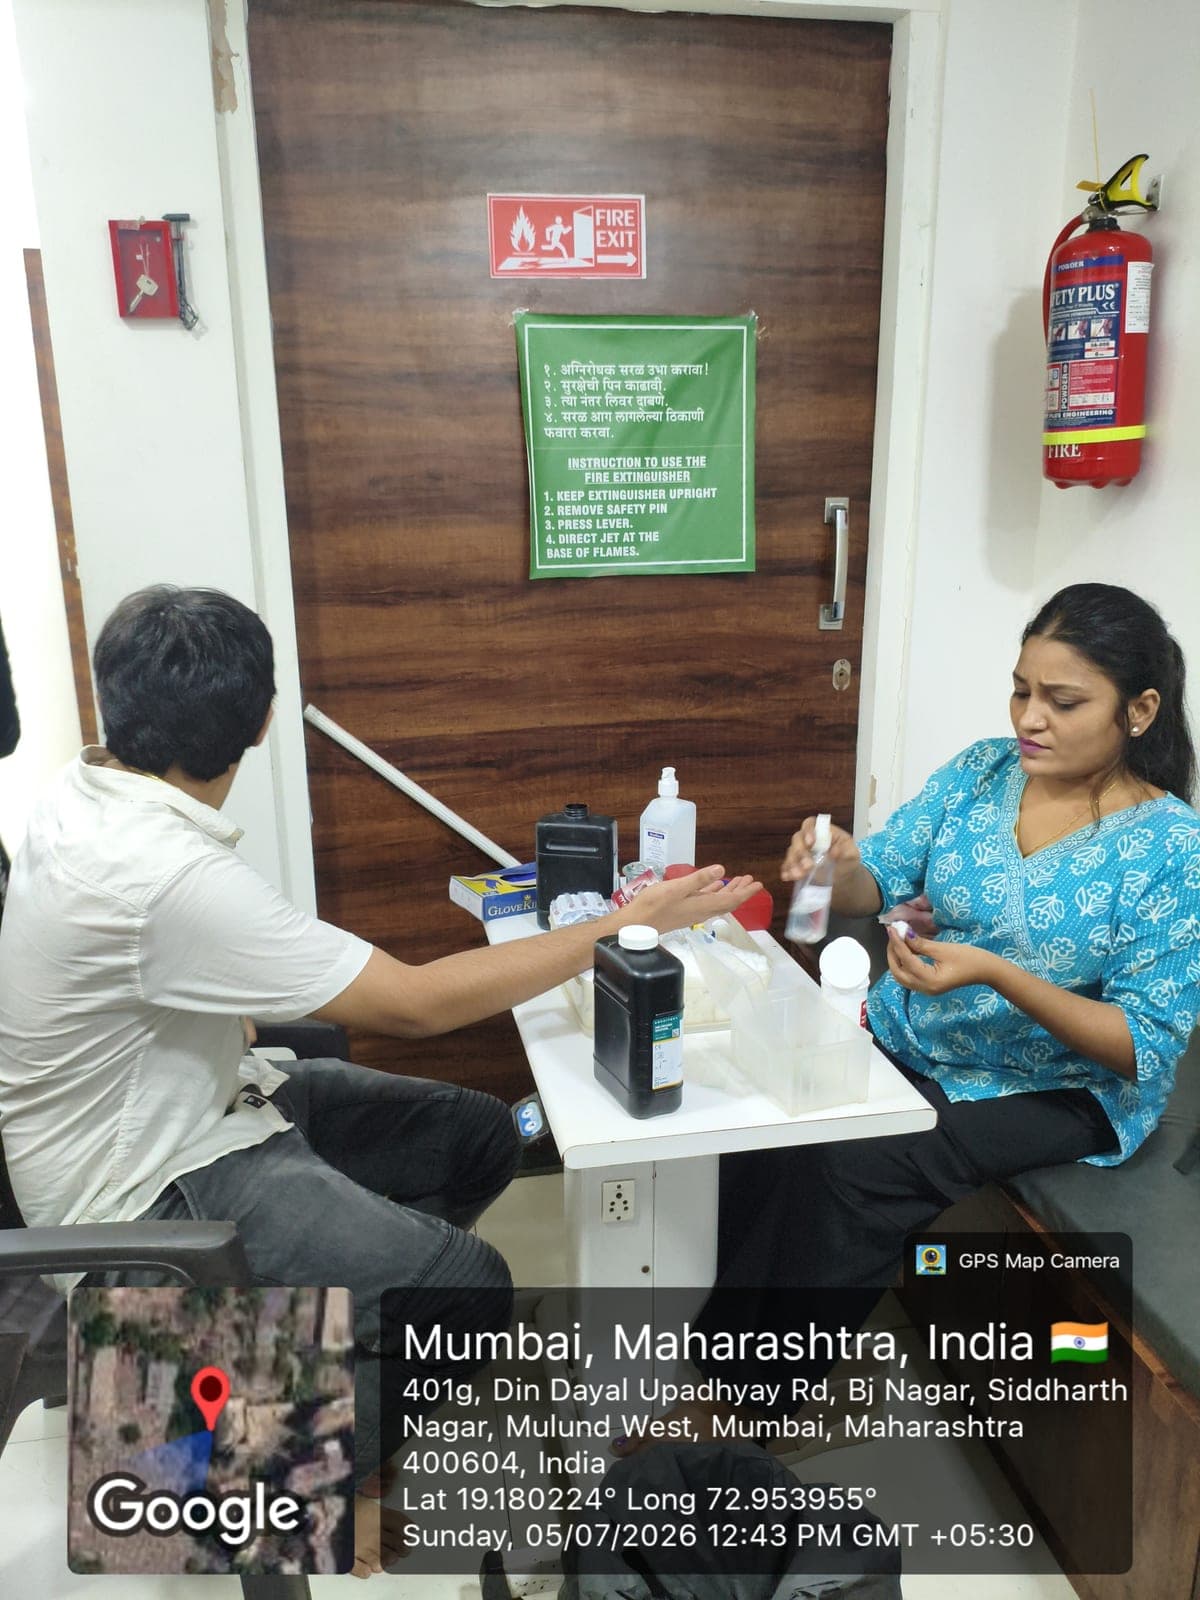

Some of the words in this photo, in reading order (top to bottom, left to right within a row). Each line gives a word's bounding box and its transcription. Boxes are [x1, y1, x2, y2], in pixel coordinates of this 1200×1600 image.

[595, 208, 635, 227] FIRE
[596, 230, 636, 248] EXIT
[1078, 283, 1116, 303] PLUS
[1061, 373, 1069, 410] POWDER
[1047, 443, 1081, 458] FIRE
[568, 457, 641, 469] INSTRUCTION
[645, 457, 658, 467] TO
[662, 456, 683, 467] USE
[686, 456, 707, 467] THE
[585, 471, 610, 483] FIRE
[613, 470, 691, 483] EXTINGUISHER
[544, 491, 554, 502] 1.
[556, 491, 585, 502] KEEP
[588, 489, 666, 501] EXTINGUISHER
[669, 487, 718, 499] UPRIGHT
[544, 506, 555, 517] 2.
[557, 505, 604, 516] REMOVE
[606, 504, 646, 515] SAFETY
[649, 503, 668, 514] PIN
[545, 521, 555, 531] 3.
[557, 519, 593, 530] PRESS
[596, 518, 634, 529] LEVER.
[545, 535, 556, 545] 4.
[558, 533, 597, 545] DIRECT
[600, 533, 620, 544] JET
[622, 533, 636, 543] AT
[638, 532, 660, 542] THE
[546, 548, 573, 559] BASE
[575, 547, 590, 558] OF
[592, 546, 640, 558] FLAMES.
[487, 900, 537, 917] GLOVEKI
